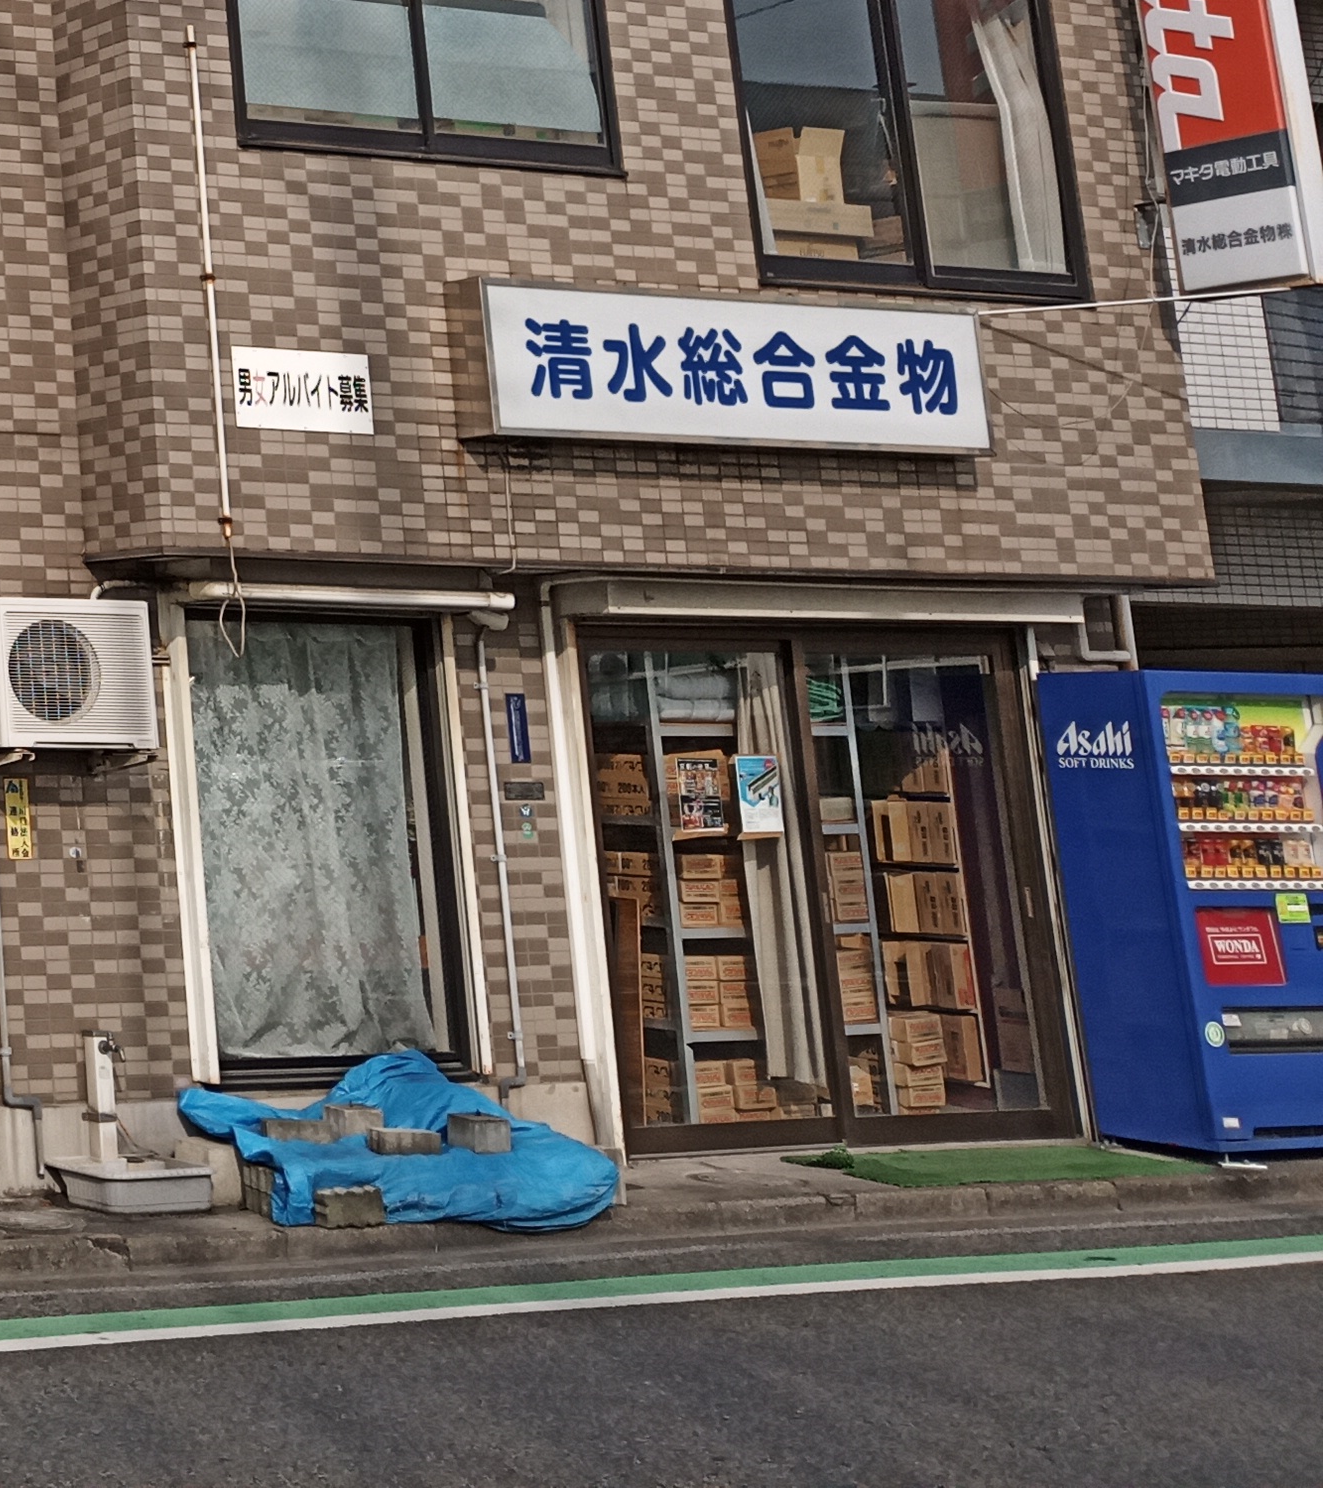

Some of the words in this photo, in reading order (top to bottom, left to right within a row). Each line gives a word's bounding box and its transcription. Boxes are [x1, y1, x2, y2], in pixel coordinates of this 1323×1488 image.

[1169, 150, 1280, 185] マキタ電動工具
[524, 317, 958, 416] 清水総合金物
[238, 367, 369, 413] 男女アルバイト募集
[1056, 720, 1133, 757] Asahi
[1058, 757, 1087, 769] SOFT
[1090, 757, 1135, 769] DRINKS
[1214, 939, 1260, 954] WONDA
